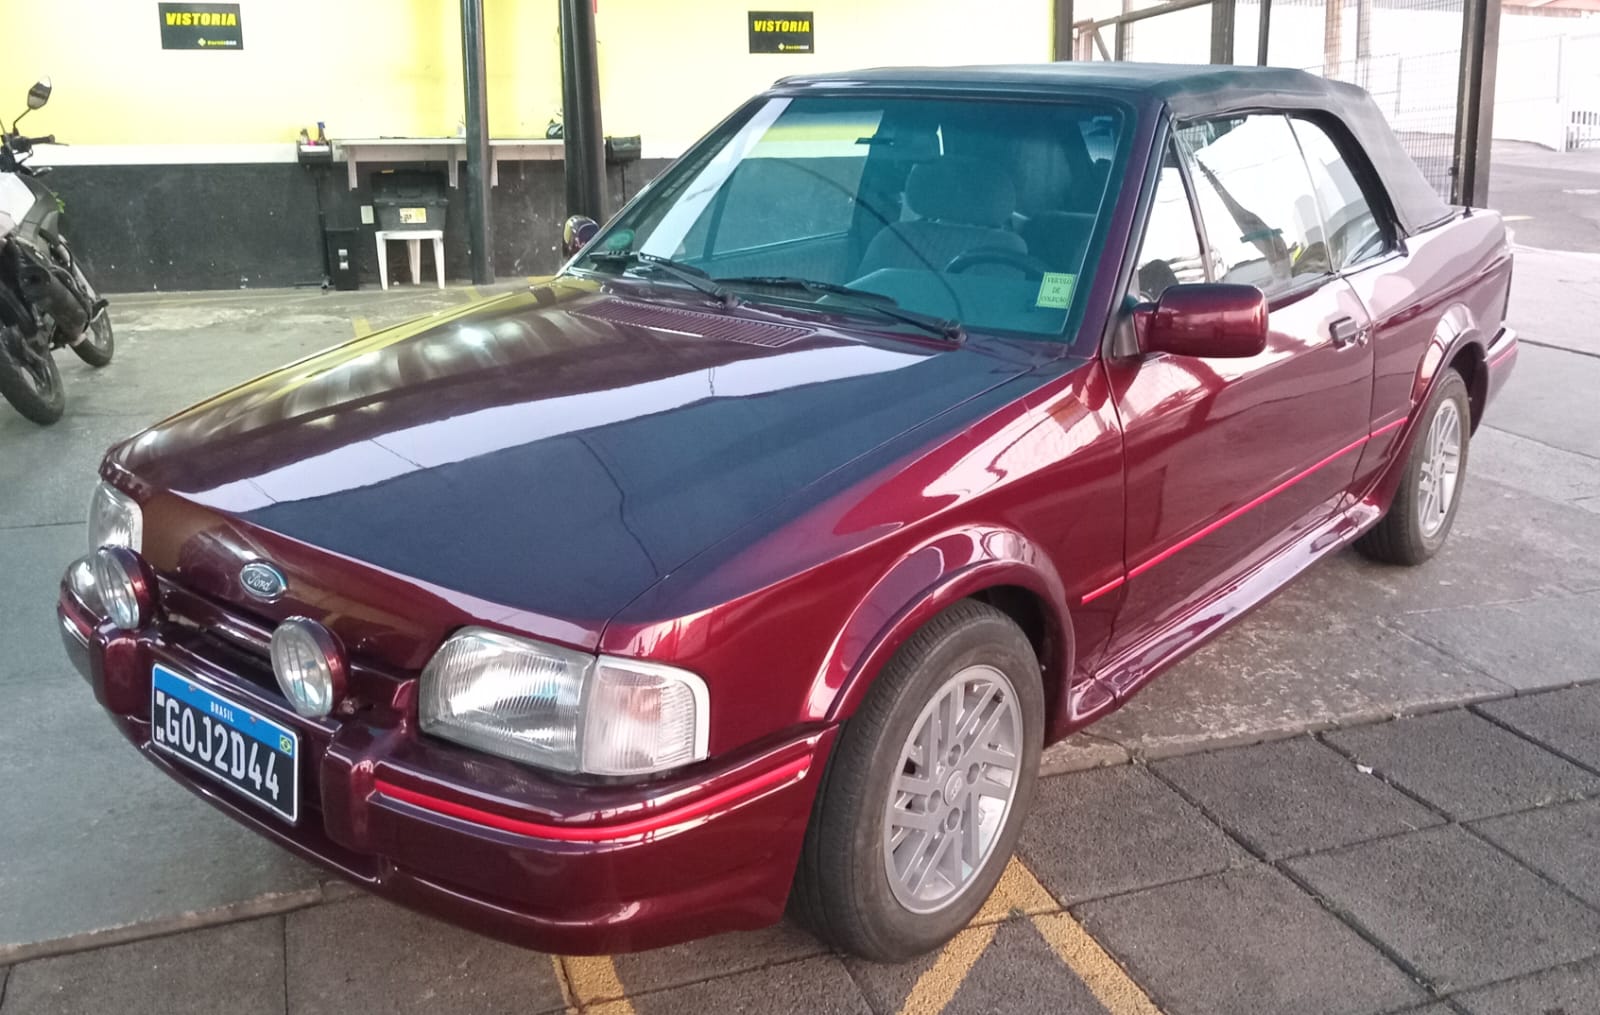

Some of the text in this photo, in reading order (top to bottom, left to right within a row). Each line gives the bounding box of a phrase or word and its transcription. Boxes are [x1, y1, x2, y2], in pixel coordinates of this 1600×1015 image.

[165, 12, 237, 26] VISTORIA
[753, 20, 810, 32] VISTORIA
[247, 570, 273, 591] Ford
[210, 701, 234, 723] BRASIL
[165, 698, 280, 801] GOJ2D44
